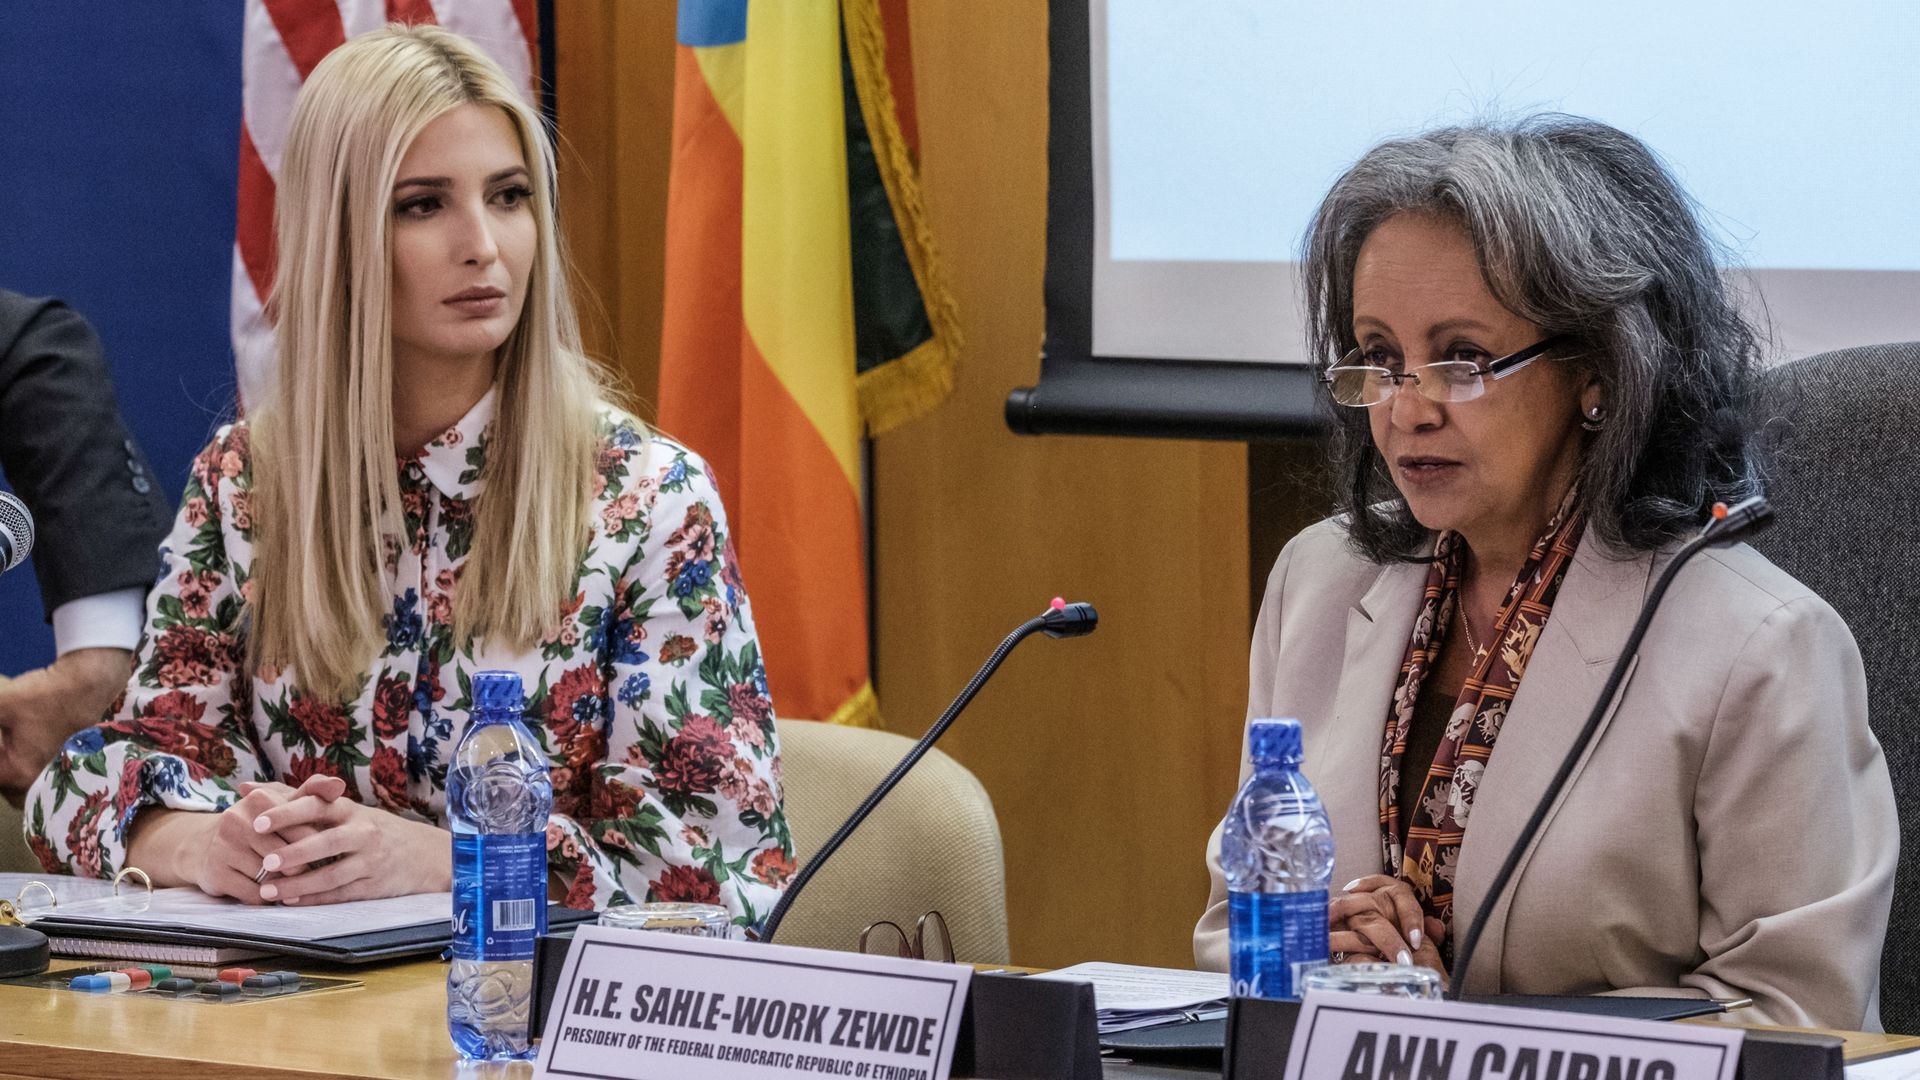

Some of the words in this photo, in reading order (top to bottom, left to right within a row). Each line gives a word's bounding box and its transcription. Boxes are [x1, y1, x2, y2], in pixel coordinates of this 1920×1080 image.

[573, 978, 623, 1019] H.E.
[630, 984, 830, 1044] SAHLE-WORK
[829, 1008, 938, 1056] ZEWDE
[563, 1026, 627, 1048] PRESIDENT
[627, 1034, 644, 1050] OF
[644, 1036, 666, 1053] THE
[666, 1039, 714, 1059] FEDERAL
[716, 1045, 794, 1069] DEMOCRATIC
[795, 1054, 854, 1076] REPUBLIC
[855, 1062, 871, 1078] OF
[873, 1064, 928, 1080] ETHIOPIA
[1341, 1030, 1458, 1080] ANN
